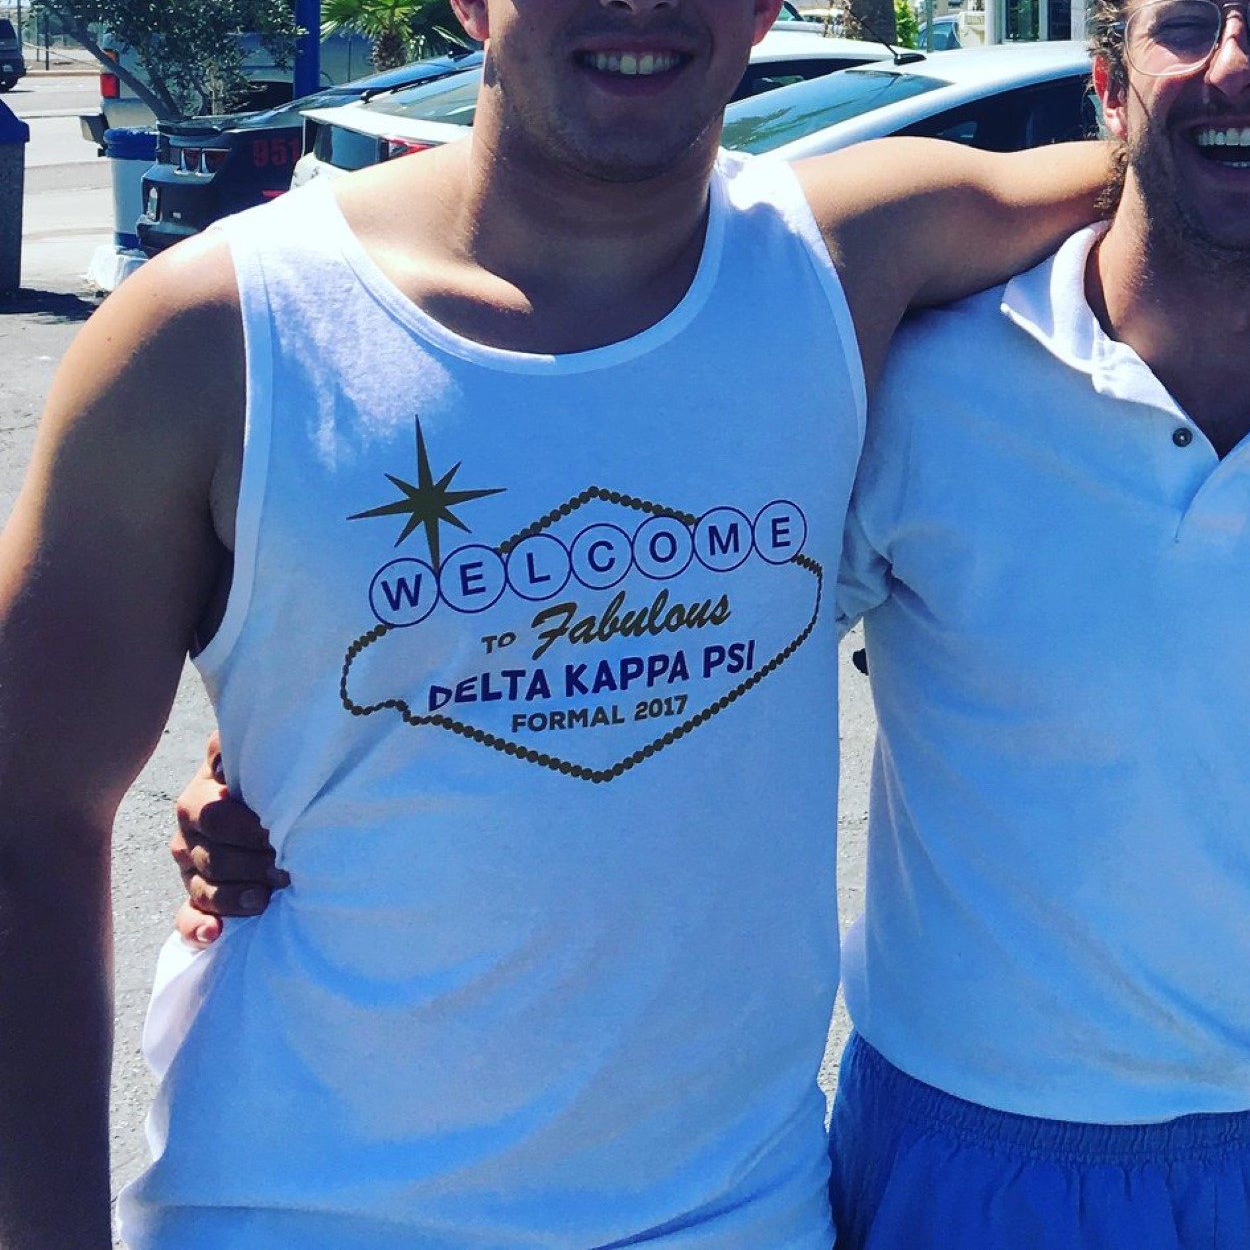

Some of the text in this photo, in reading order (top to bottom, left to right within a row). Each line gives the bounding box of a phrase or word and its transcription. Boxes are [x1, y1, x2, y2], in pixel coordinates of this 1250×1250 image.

[379, 514, 793, 613] WELCOME
[481, 588, 732, 661] TO Fabulous
[428, 639, 756, 713] DELTA KAPPA PSI
[511, 694, 689, 734] FORMAL 2017
